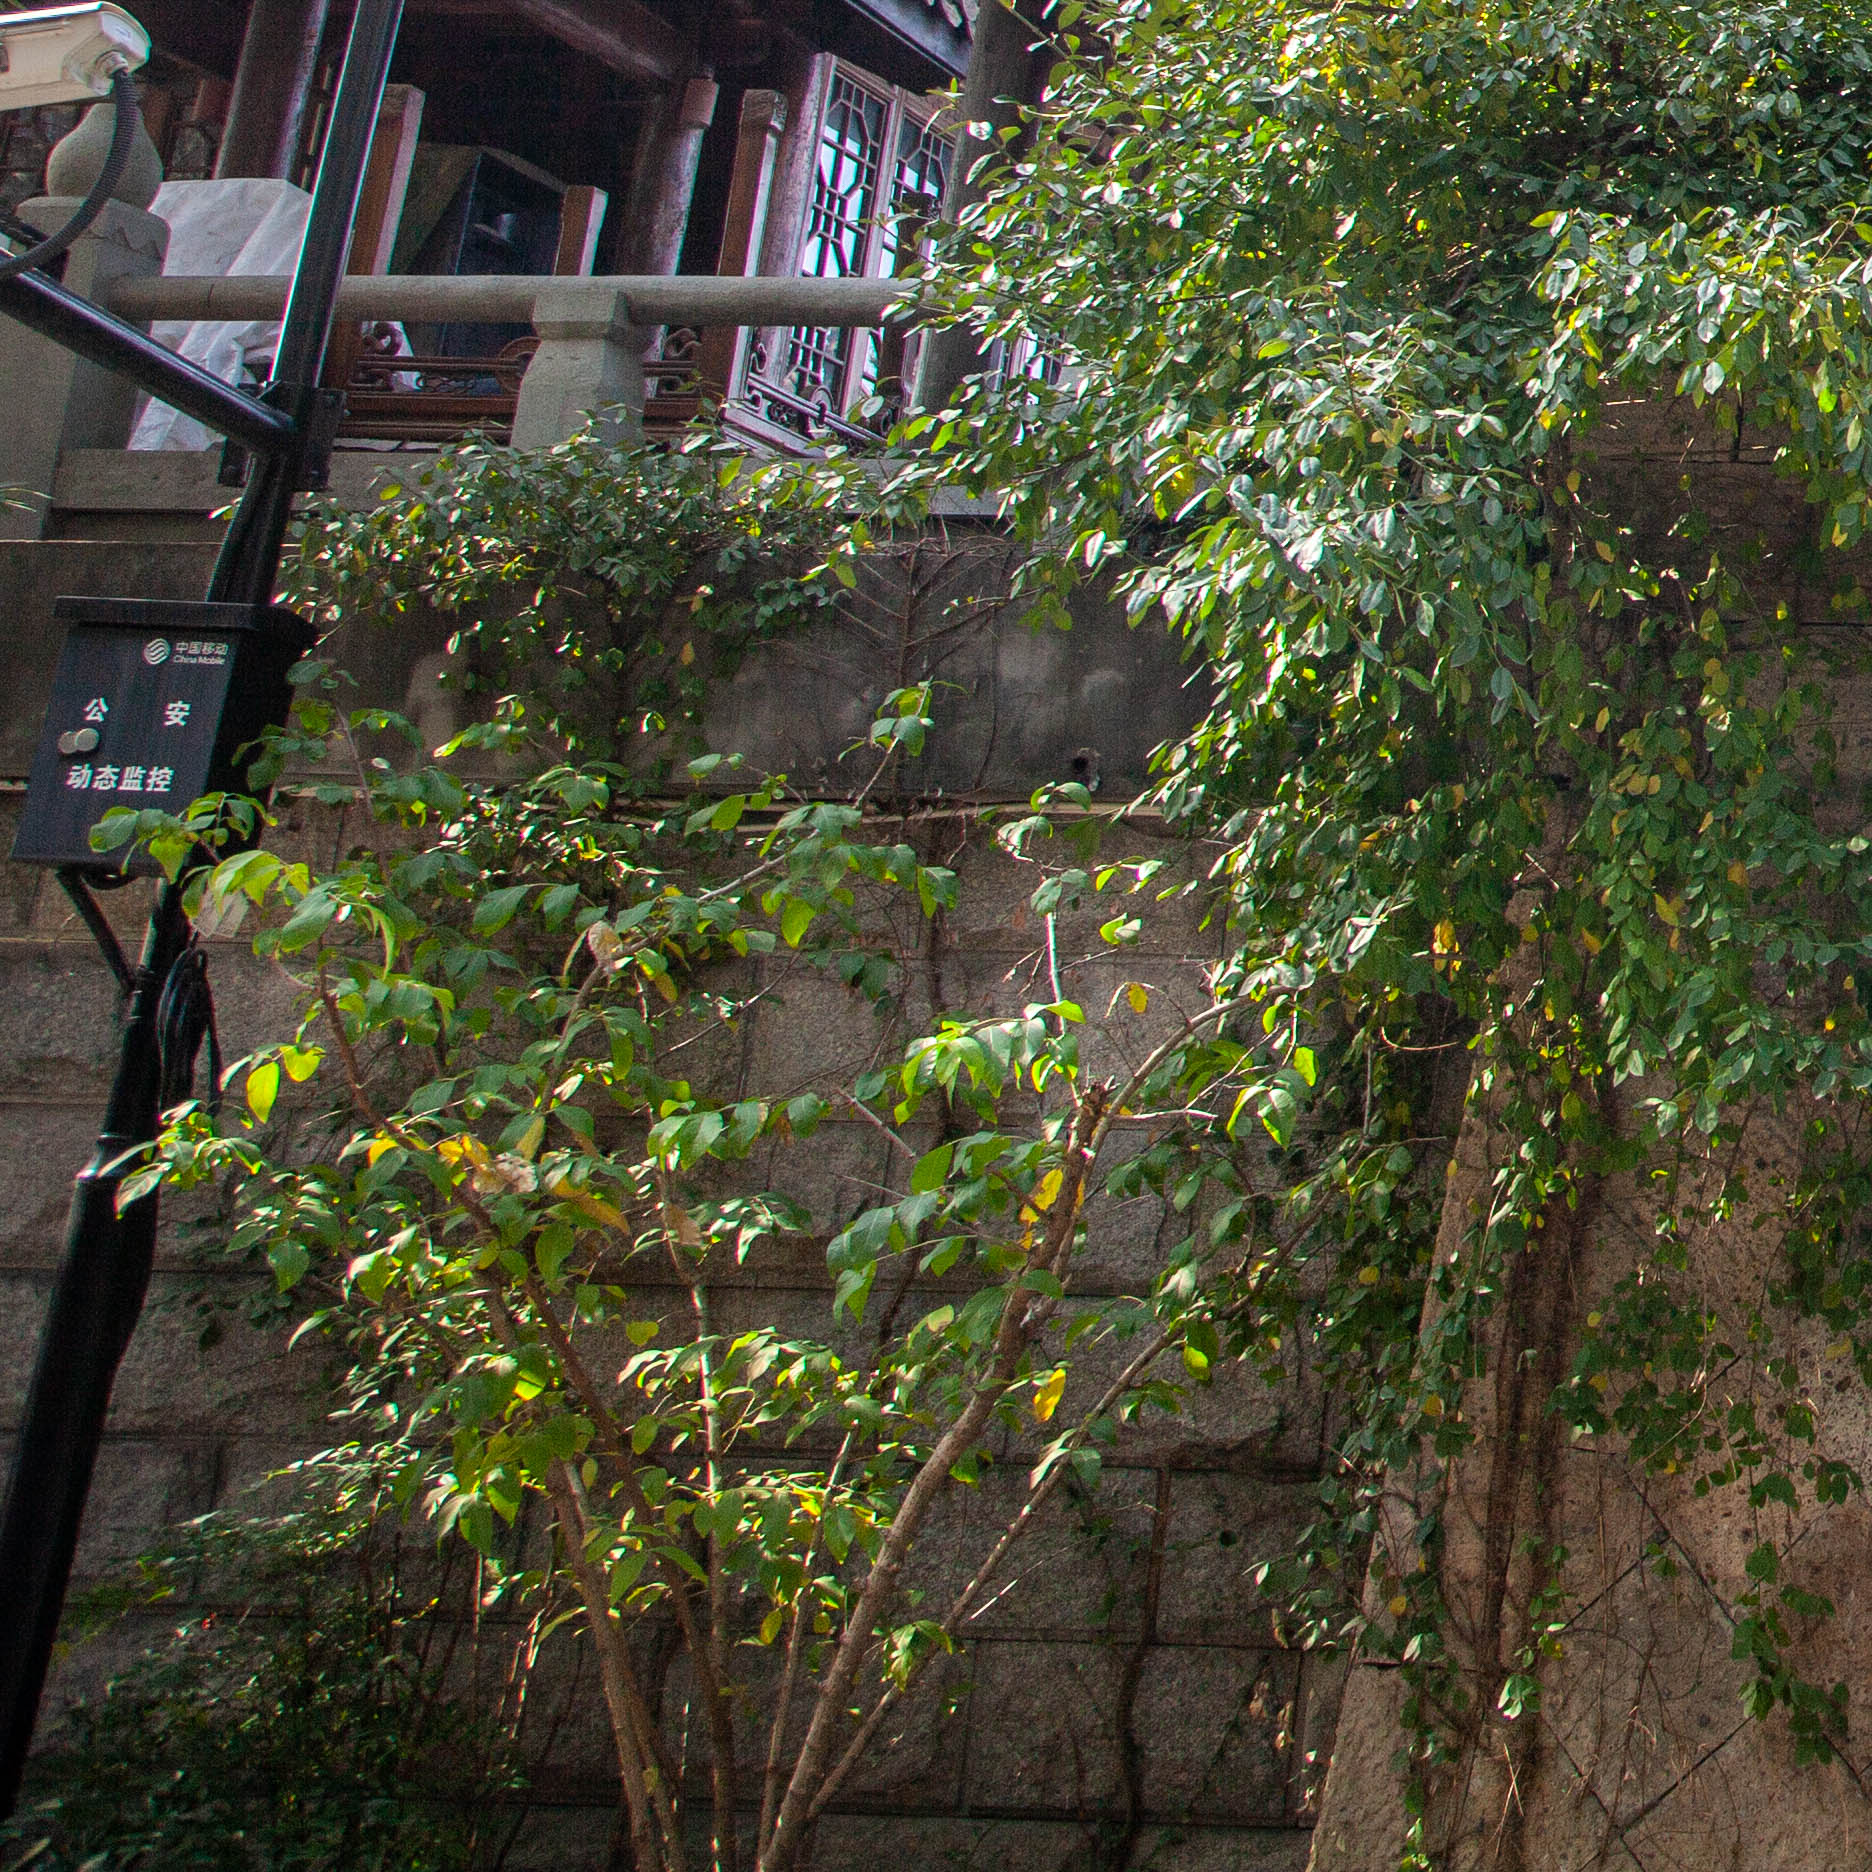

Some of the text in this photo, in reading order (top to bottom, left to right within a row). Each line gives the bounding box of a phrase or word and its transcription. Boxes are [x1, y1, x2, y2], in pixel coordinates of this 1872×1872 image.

[175, 641, 229, 656] 中国移动
[173, 655, 225, 665] China Mobile
[82, 697, 192, 727] 公安
[66, 763, 175, 793] 动态监控
